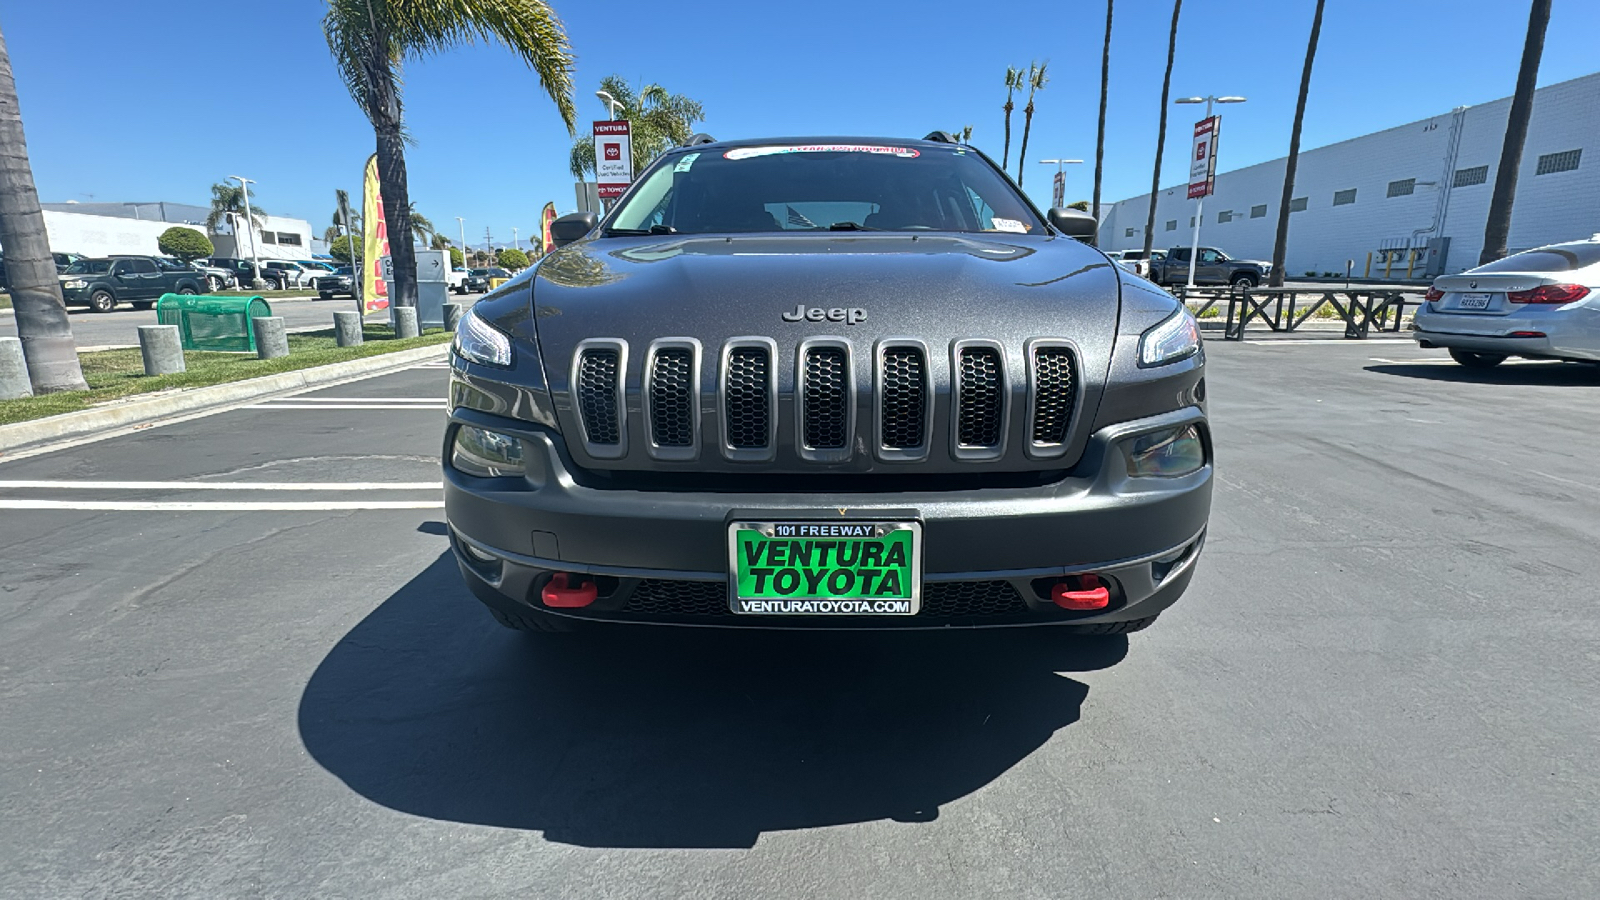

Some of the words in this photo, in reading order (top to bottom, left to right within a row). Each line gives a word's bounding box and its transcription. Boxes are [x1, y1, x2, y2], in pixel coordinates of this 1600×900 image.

[782, 305, 868, 325] Jeep
[776, 526, 796, 536] 101
[800, 526, 872, 536] FREEWAY
[744, 541, 907, 567] VENTURA
[750, 568, 902, 595] TOYOTA
[741, 601, 909, 612] VENTURATOYOTA.COM
